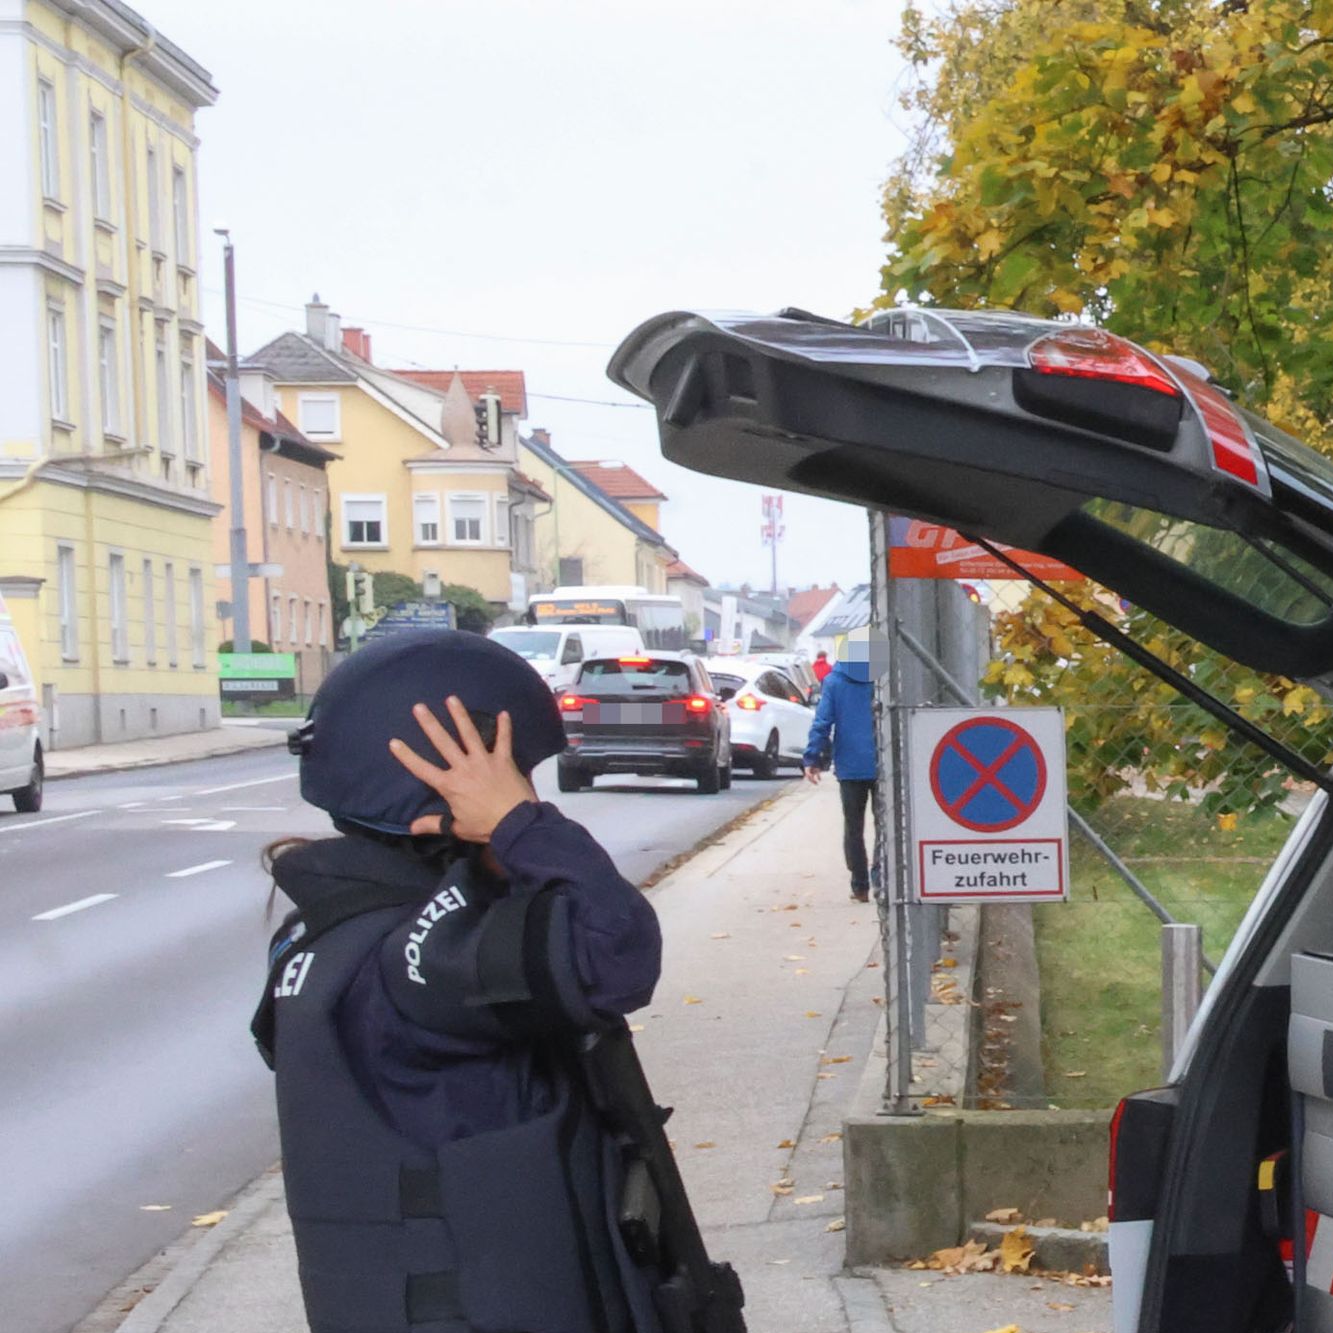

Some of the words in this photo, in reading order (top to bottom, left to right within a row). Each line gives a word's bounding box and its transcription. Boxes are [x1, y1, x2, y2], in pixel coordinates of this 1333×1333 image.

[931, 849, 1050, 865] Feuerwehr-
[954, 872, 1028, 888] zufahrt
[404, 885, 467, 985] POLIZEI
